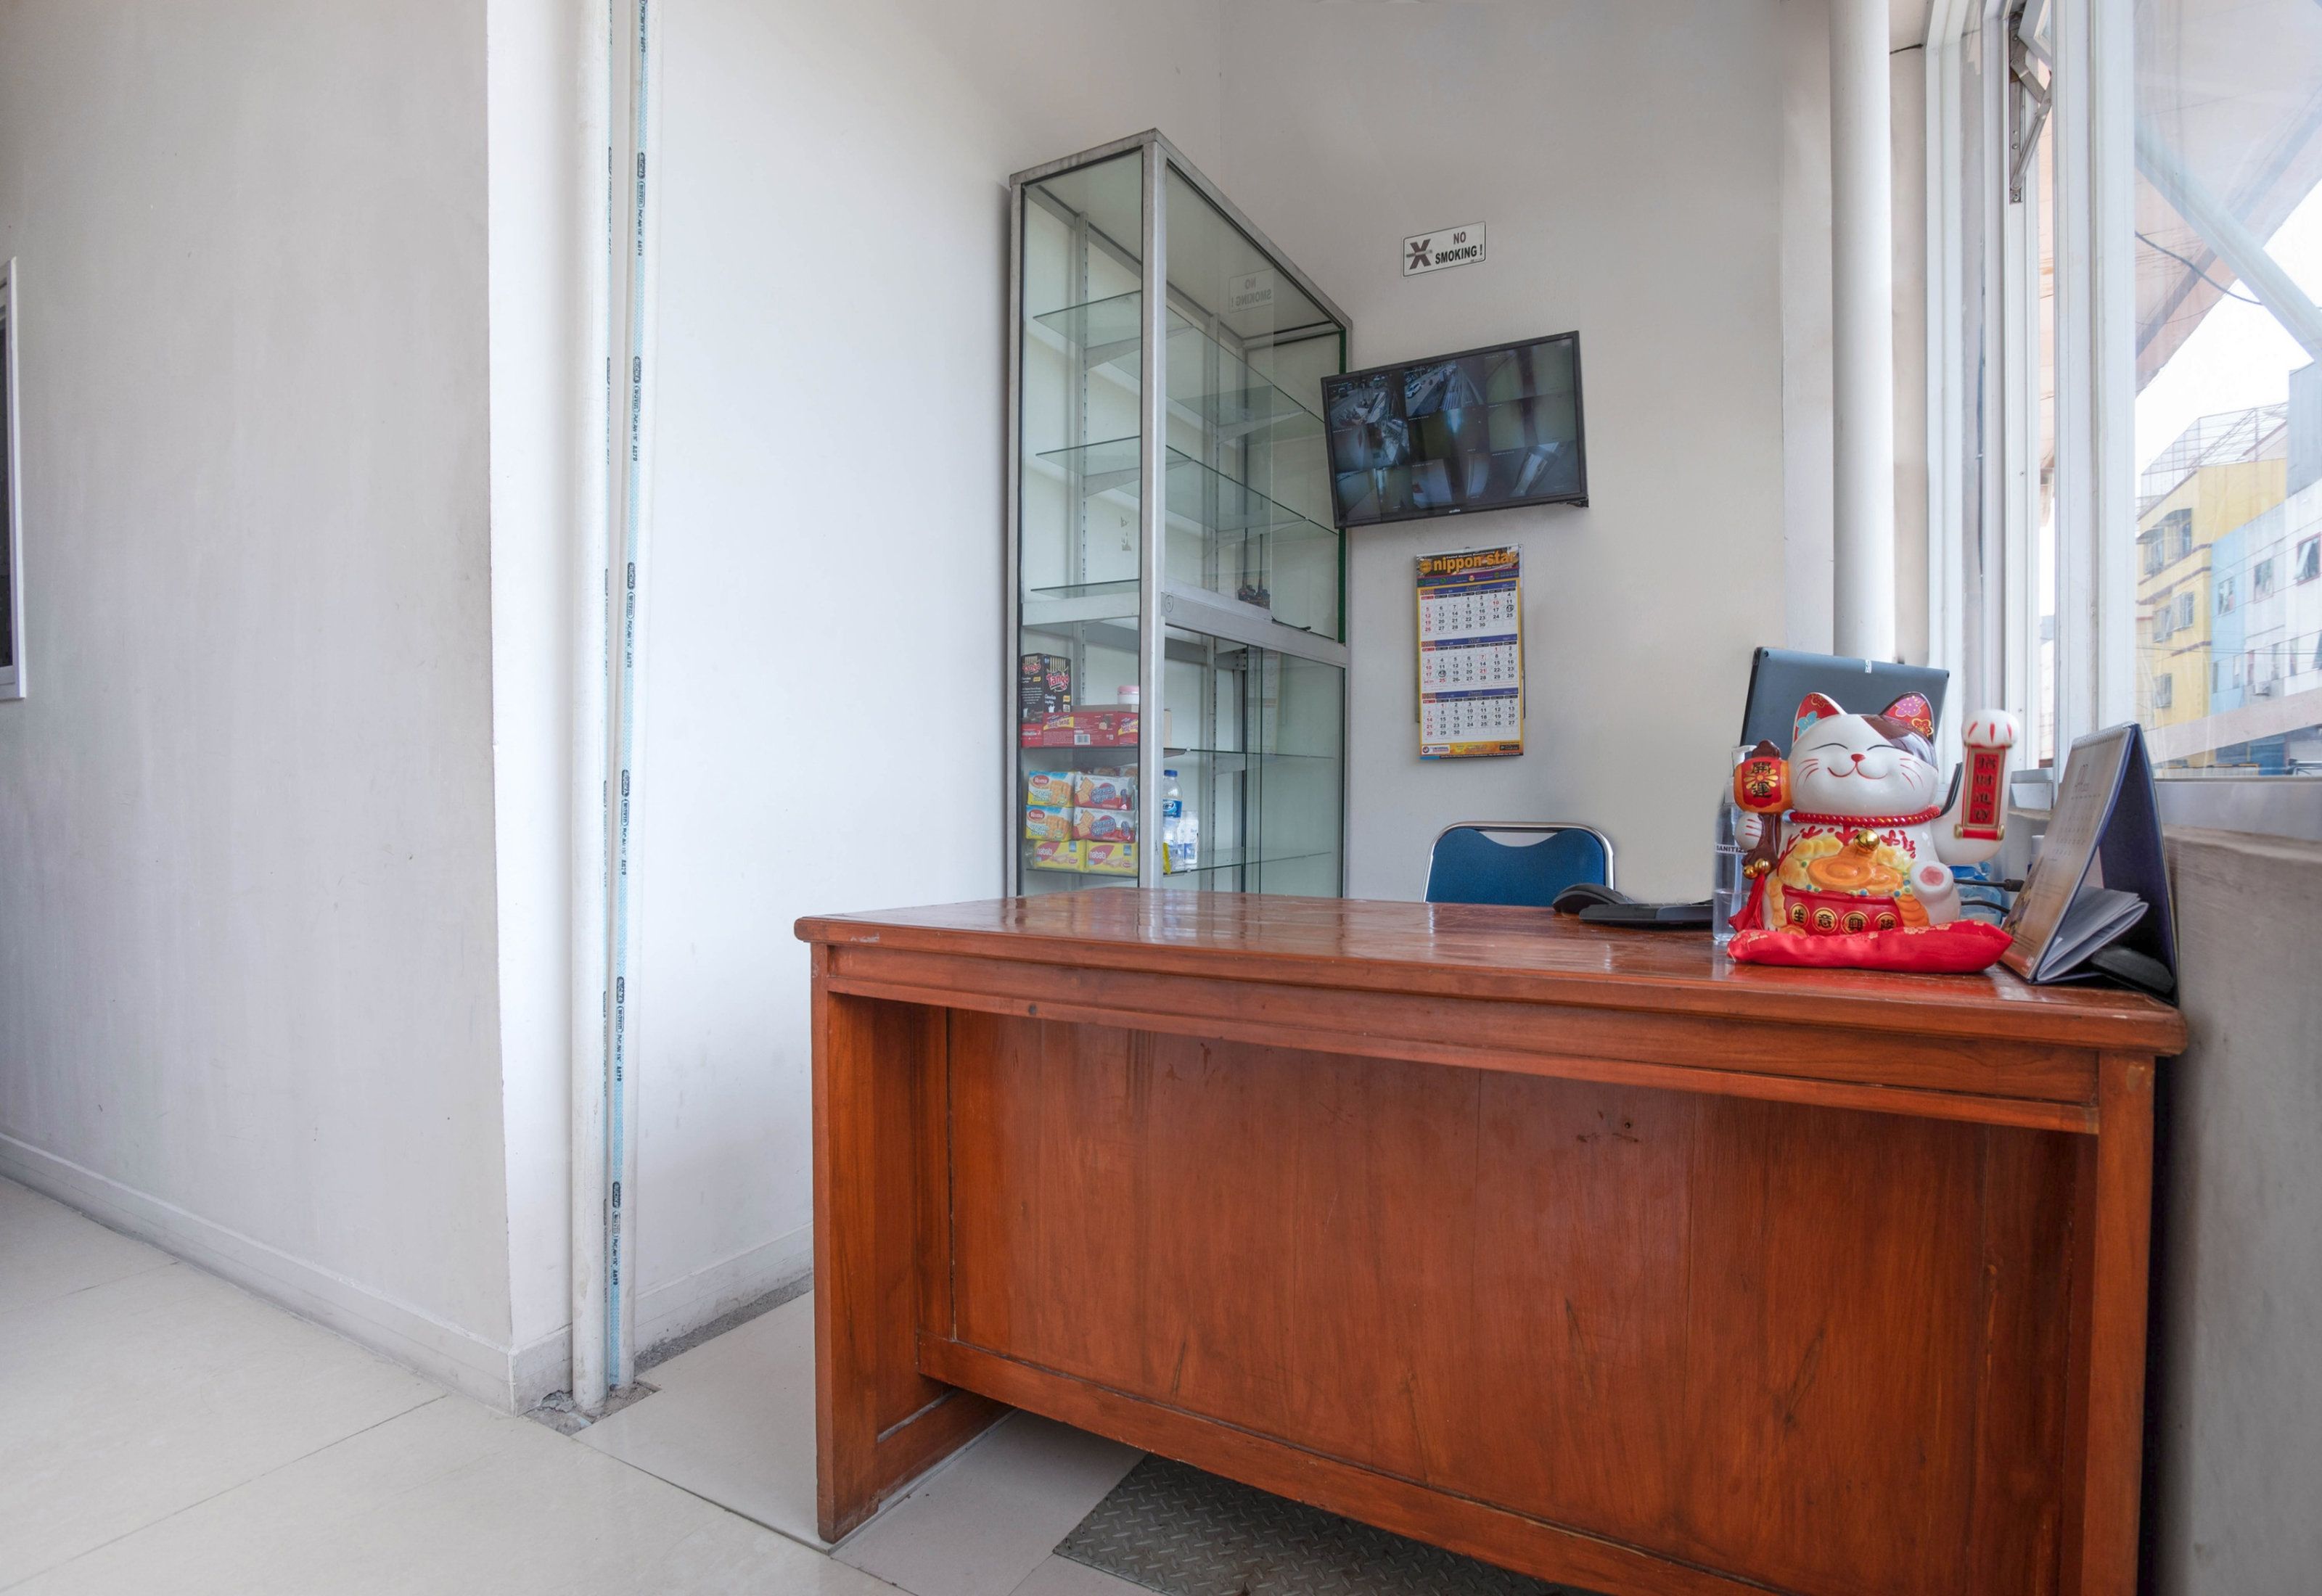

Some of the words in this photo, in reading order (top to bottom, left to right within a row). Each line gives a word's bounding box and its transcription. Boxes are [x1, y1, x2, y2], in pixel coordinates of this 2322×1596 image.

[1453, 231, 1466, 244] NO
[1435, 244, 1477, 264] SMOKING
[1434, 556, 1482, 573] nippon
[1046, 672, 1070, 690] Tango
[1751, 761, 1772, 799] 開運
